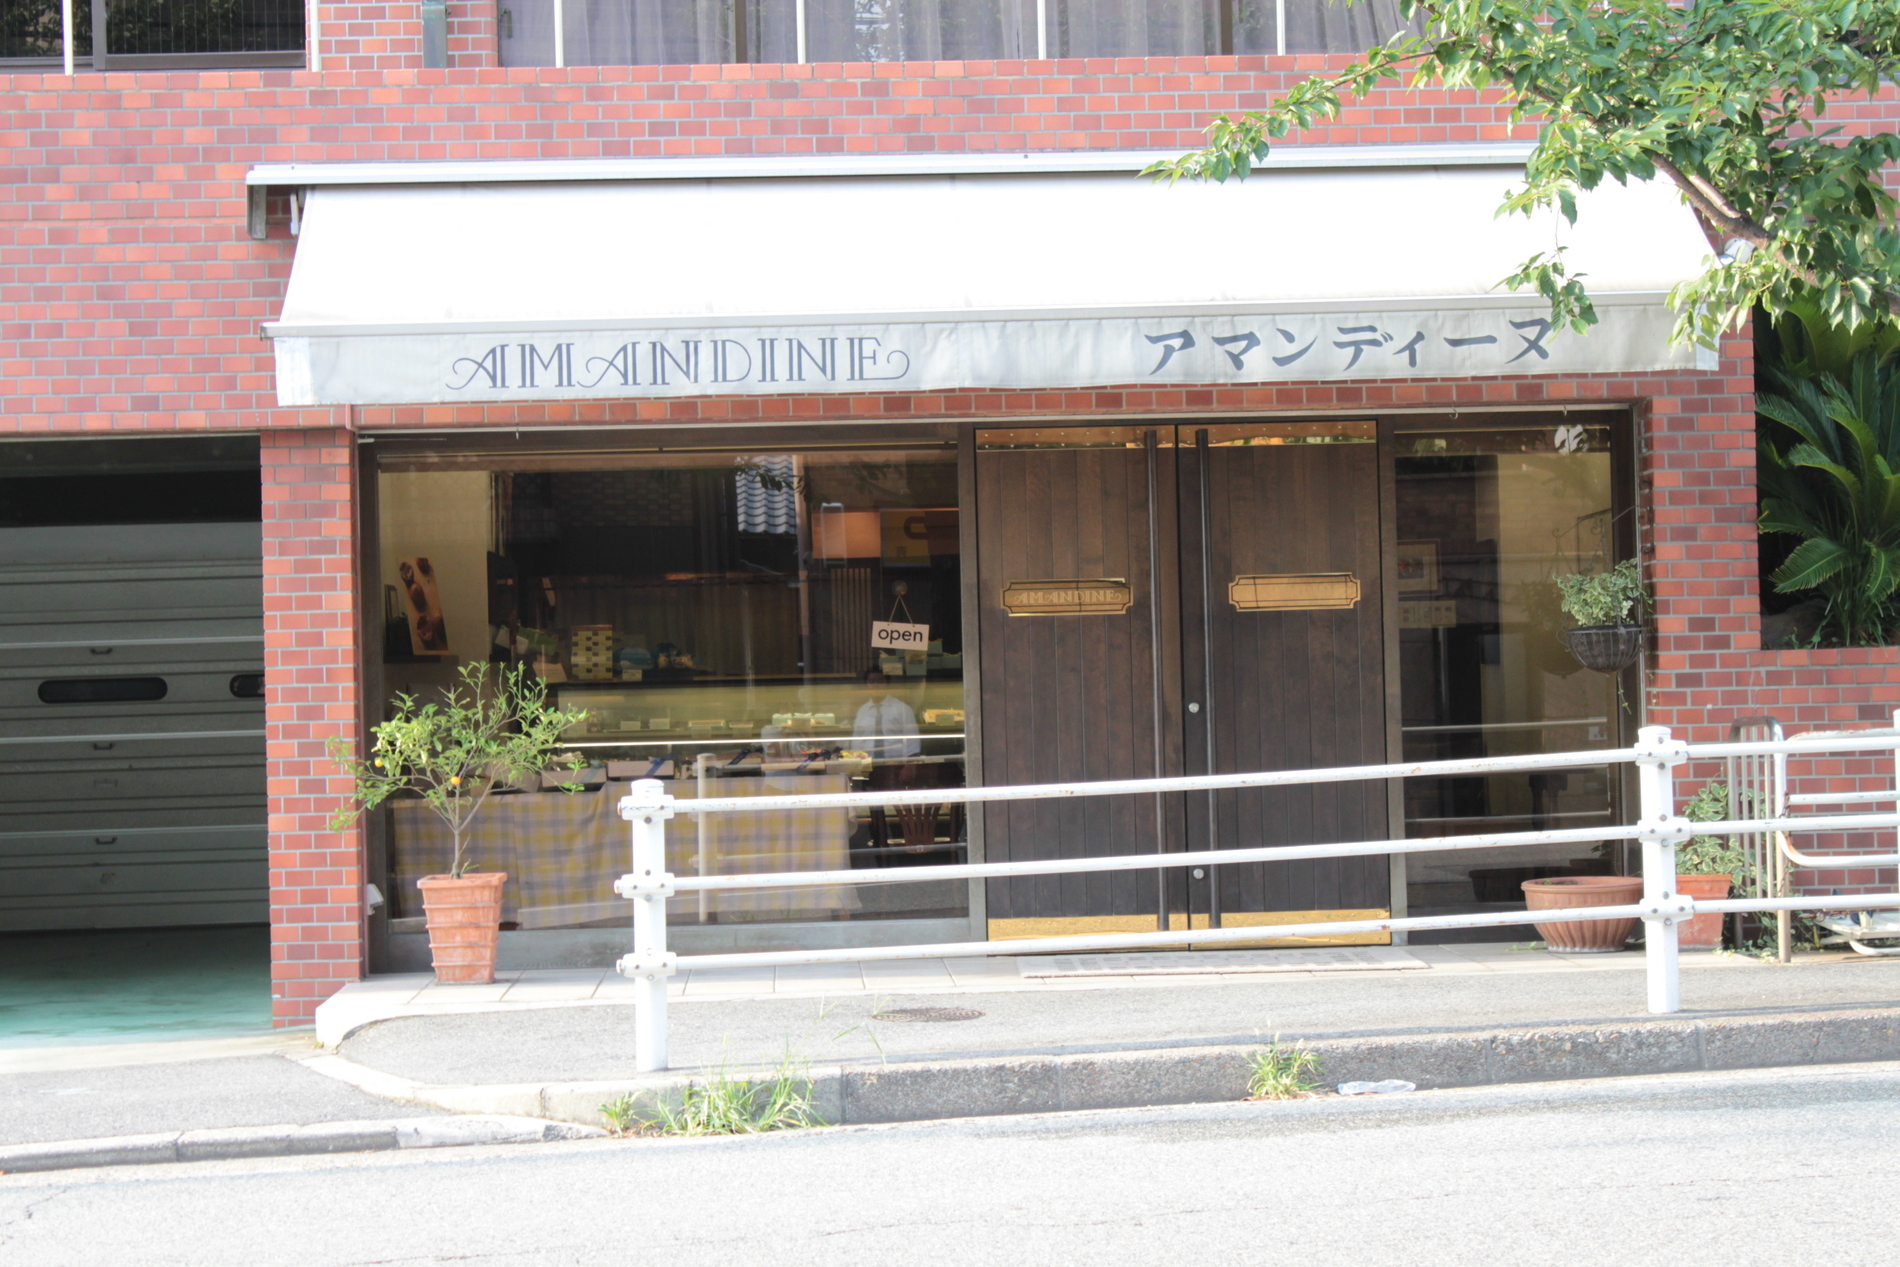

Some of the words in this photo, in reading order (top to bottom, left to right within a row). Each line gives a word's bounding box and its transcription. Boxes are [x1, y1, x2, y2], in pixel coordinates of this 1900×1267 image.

[1145, 317, 1552, 375] アマンディーヌ
[445, 337, 910, 390] AMANDINE
[1013, 589, 1122, 605] AMANDINE
[878, 629, 923, 645] open
